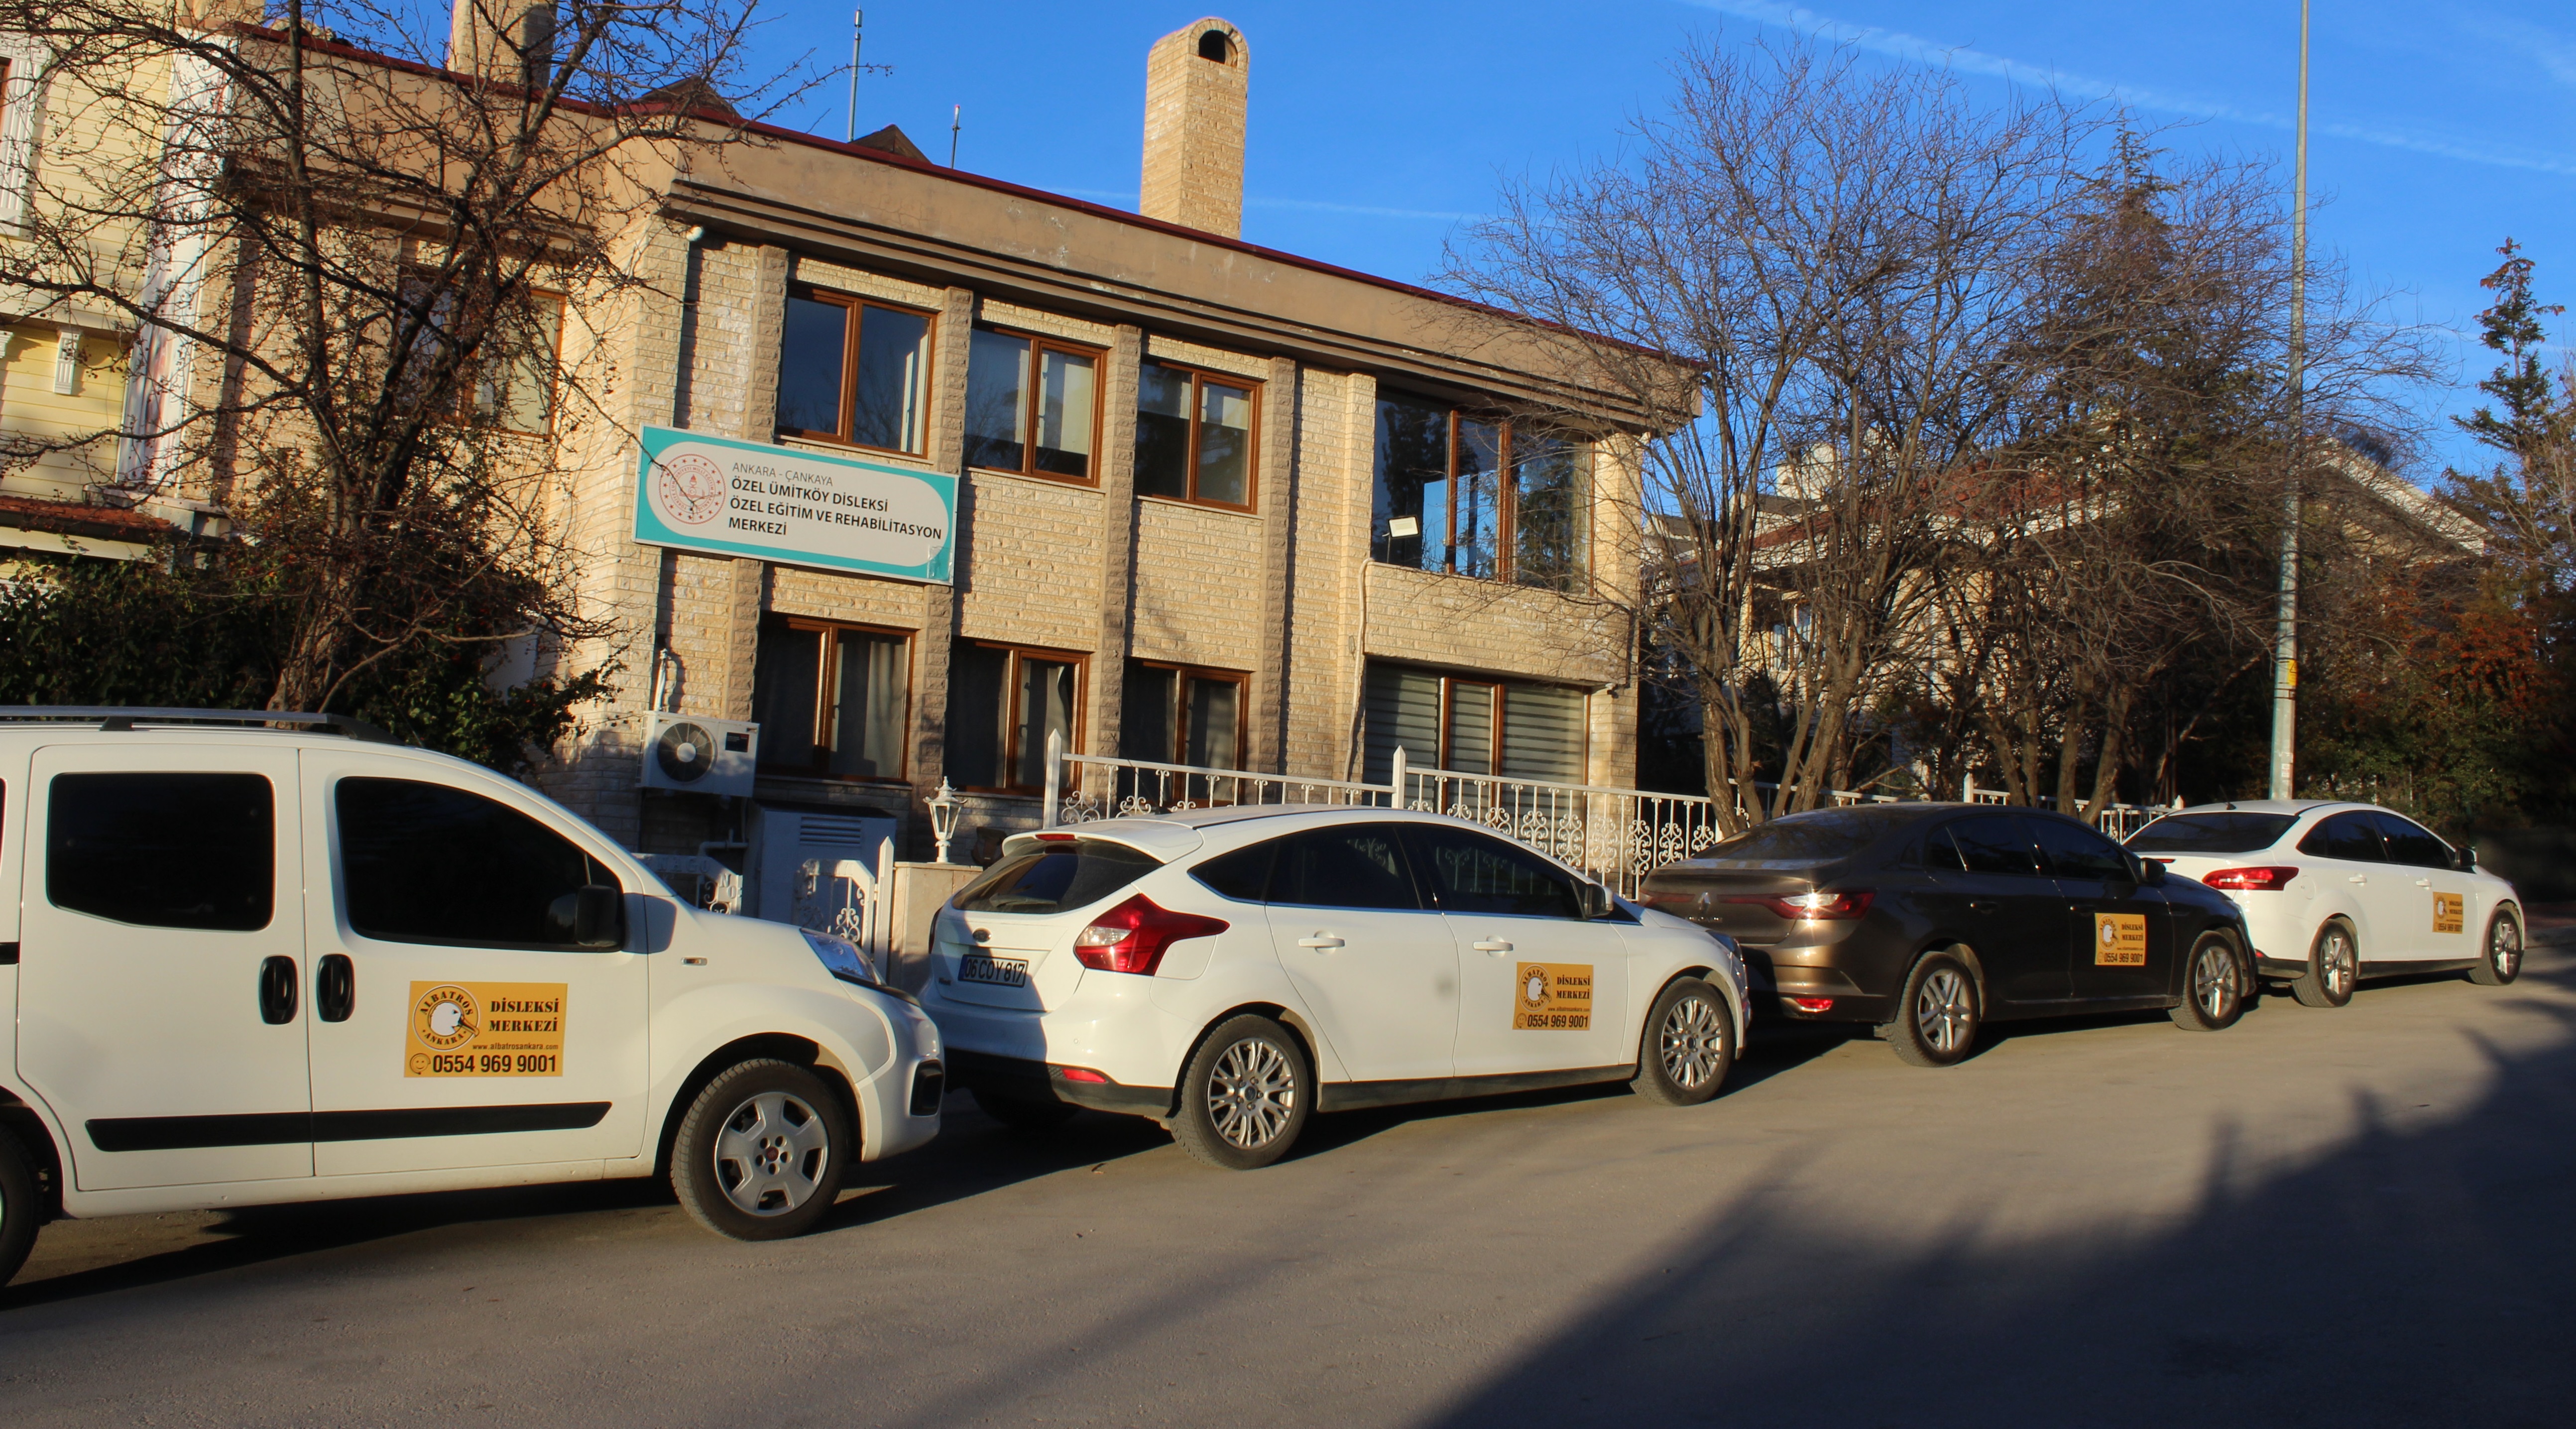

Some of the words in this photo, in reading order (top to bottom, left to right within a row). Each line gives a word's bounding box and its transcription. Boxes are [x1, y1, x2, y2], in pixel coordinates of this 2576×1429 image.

[732, 463, 776, 478] ANKARA
[785, 470, 833, 486] ÇANKAYA
[732, 475, 766, 493] ÖZEL
[770, 481, 829, 502] ÜMİTKÖY
[832, 492, 888, 512] DİSLEKSİ
[730, 495, 764, 513] ÖZEL
[767, 501, 813, 520] EĞİTİM
[817, 510, 832, 522] VE
[835, 512, 941, 539] REHABİLİTASYON
[728, 517, 787, 535] MERKEZİ
[2104, 953, 2117, 962] 0554
[2119, 953, 2129, 962] 969
[965, 958, 978, 978] 06
[1004, 962, 1025, 983] 817
[1557, 974, 1590, 985] DİSLEKSİ
[1556, 989, 1589, 999] MERKEZİ
[420, 990, 473, 1016] ALBATROS
[490, 997, 559, 1013] DİSLEKSİ
[489, 1017, 558, 1032] MERKEZİ
[1527, 1014, 1548, 1027] 0554
[1551, 1015, 1566, 1028] 969
[1568, 1015, 1588, 1028] 9001
[424, 1032, 464, 1045] ANKARA
[433, 1055, 475, 1073] 0554
[480, 1054, 511, 1072] 969
[517, 1054, 556, 1072] 9001
